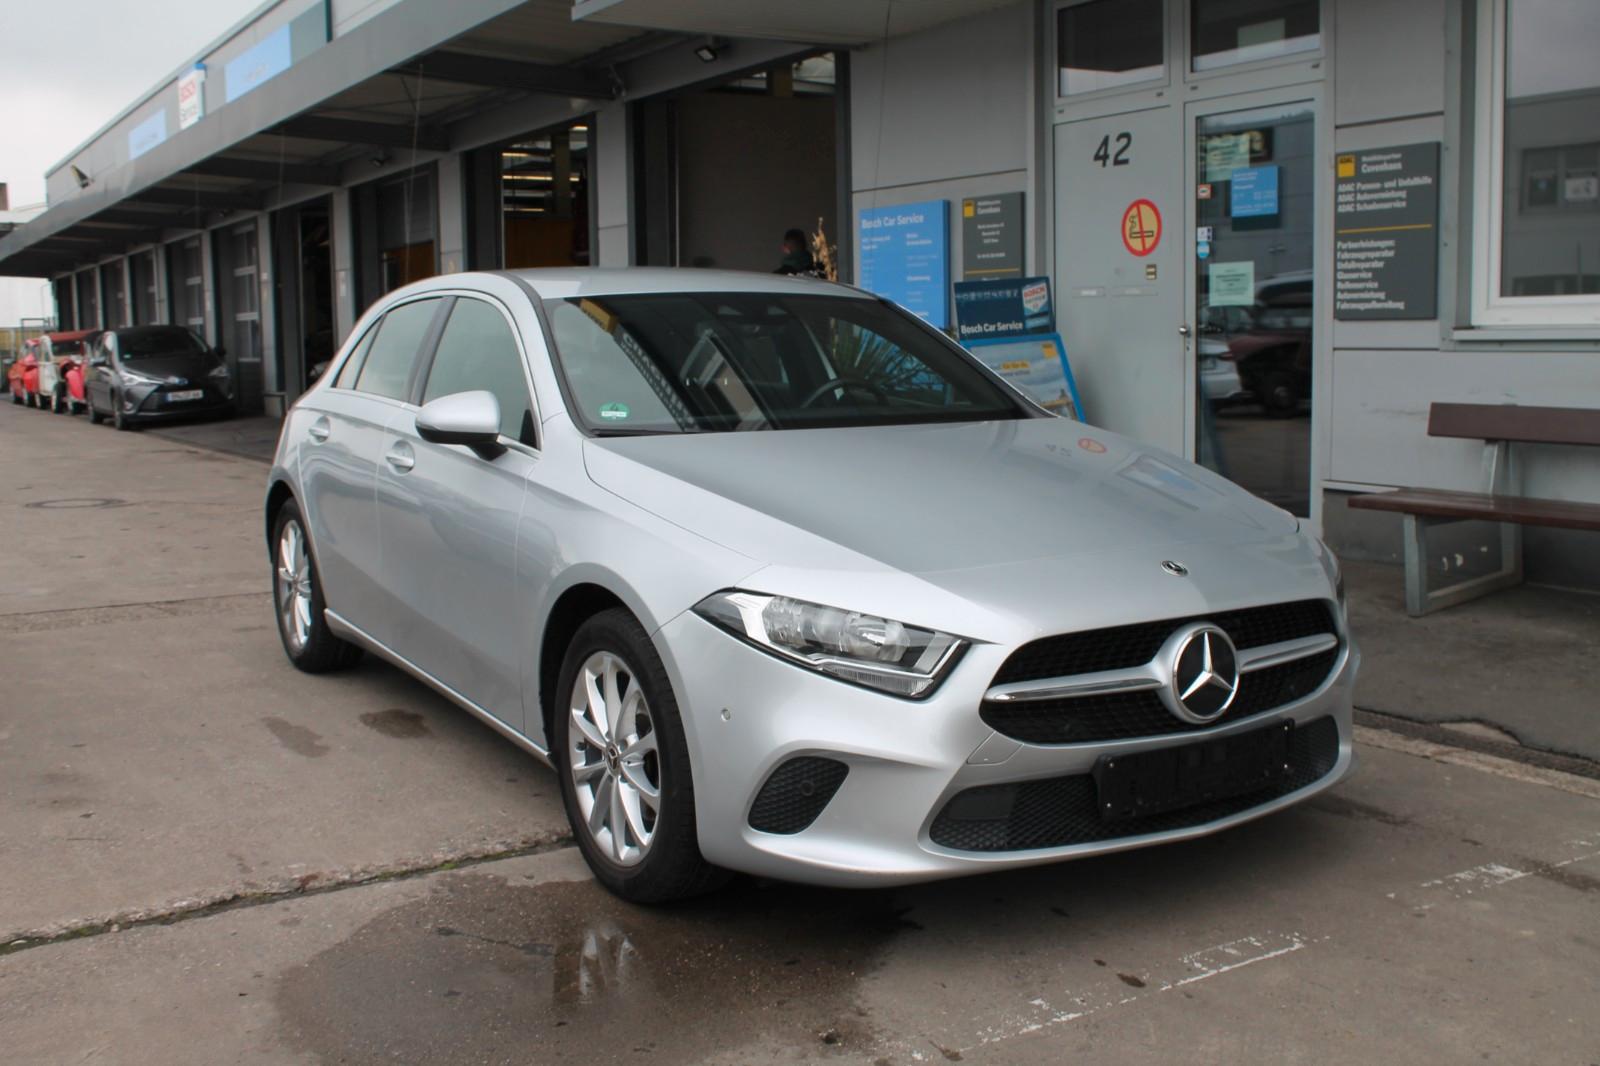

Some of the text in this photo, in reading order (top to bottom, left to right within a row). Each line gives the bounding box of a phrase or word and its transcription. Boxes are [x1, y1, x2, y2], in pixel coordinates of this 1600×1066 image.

[1093, 131, 1132, 168] 42
[862, 212, 924, 229] Bosch Car Service
[961, 323, 982, 334] Bosch
[984, 323, 995, 332] Car
[997, 320, 1023, 331] Service
